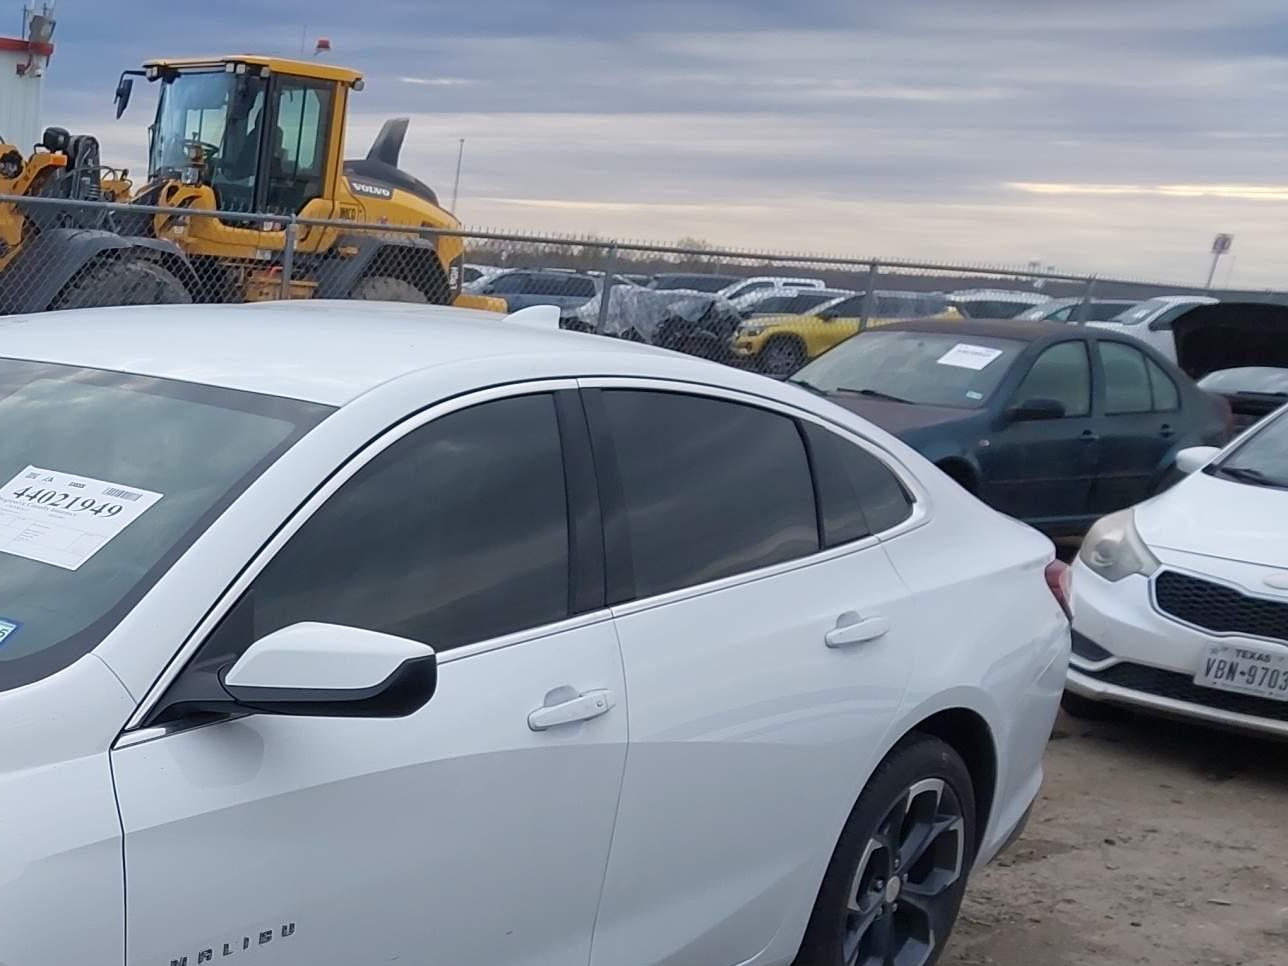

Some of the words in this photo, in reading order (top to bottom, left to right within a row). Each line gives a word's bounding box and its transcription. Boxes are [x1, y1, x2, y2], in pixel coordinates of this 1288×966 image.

[352, 182, 391, 197] VOLVO
[13, 486, 123, 520] 44021949
[1235, 648, 1271, 663] TEXAS
